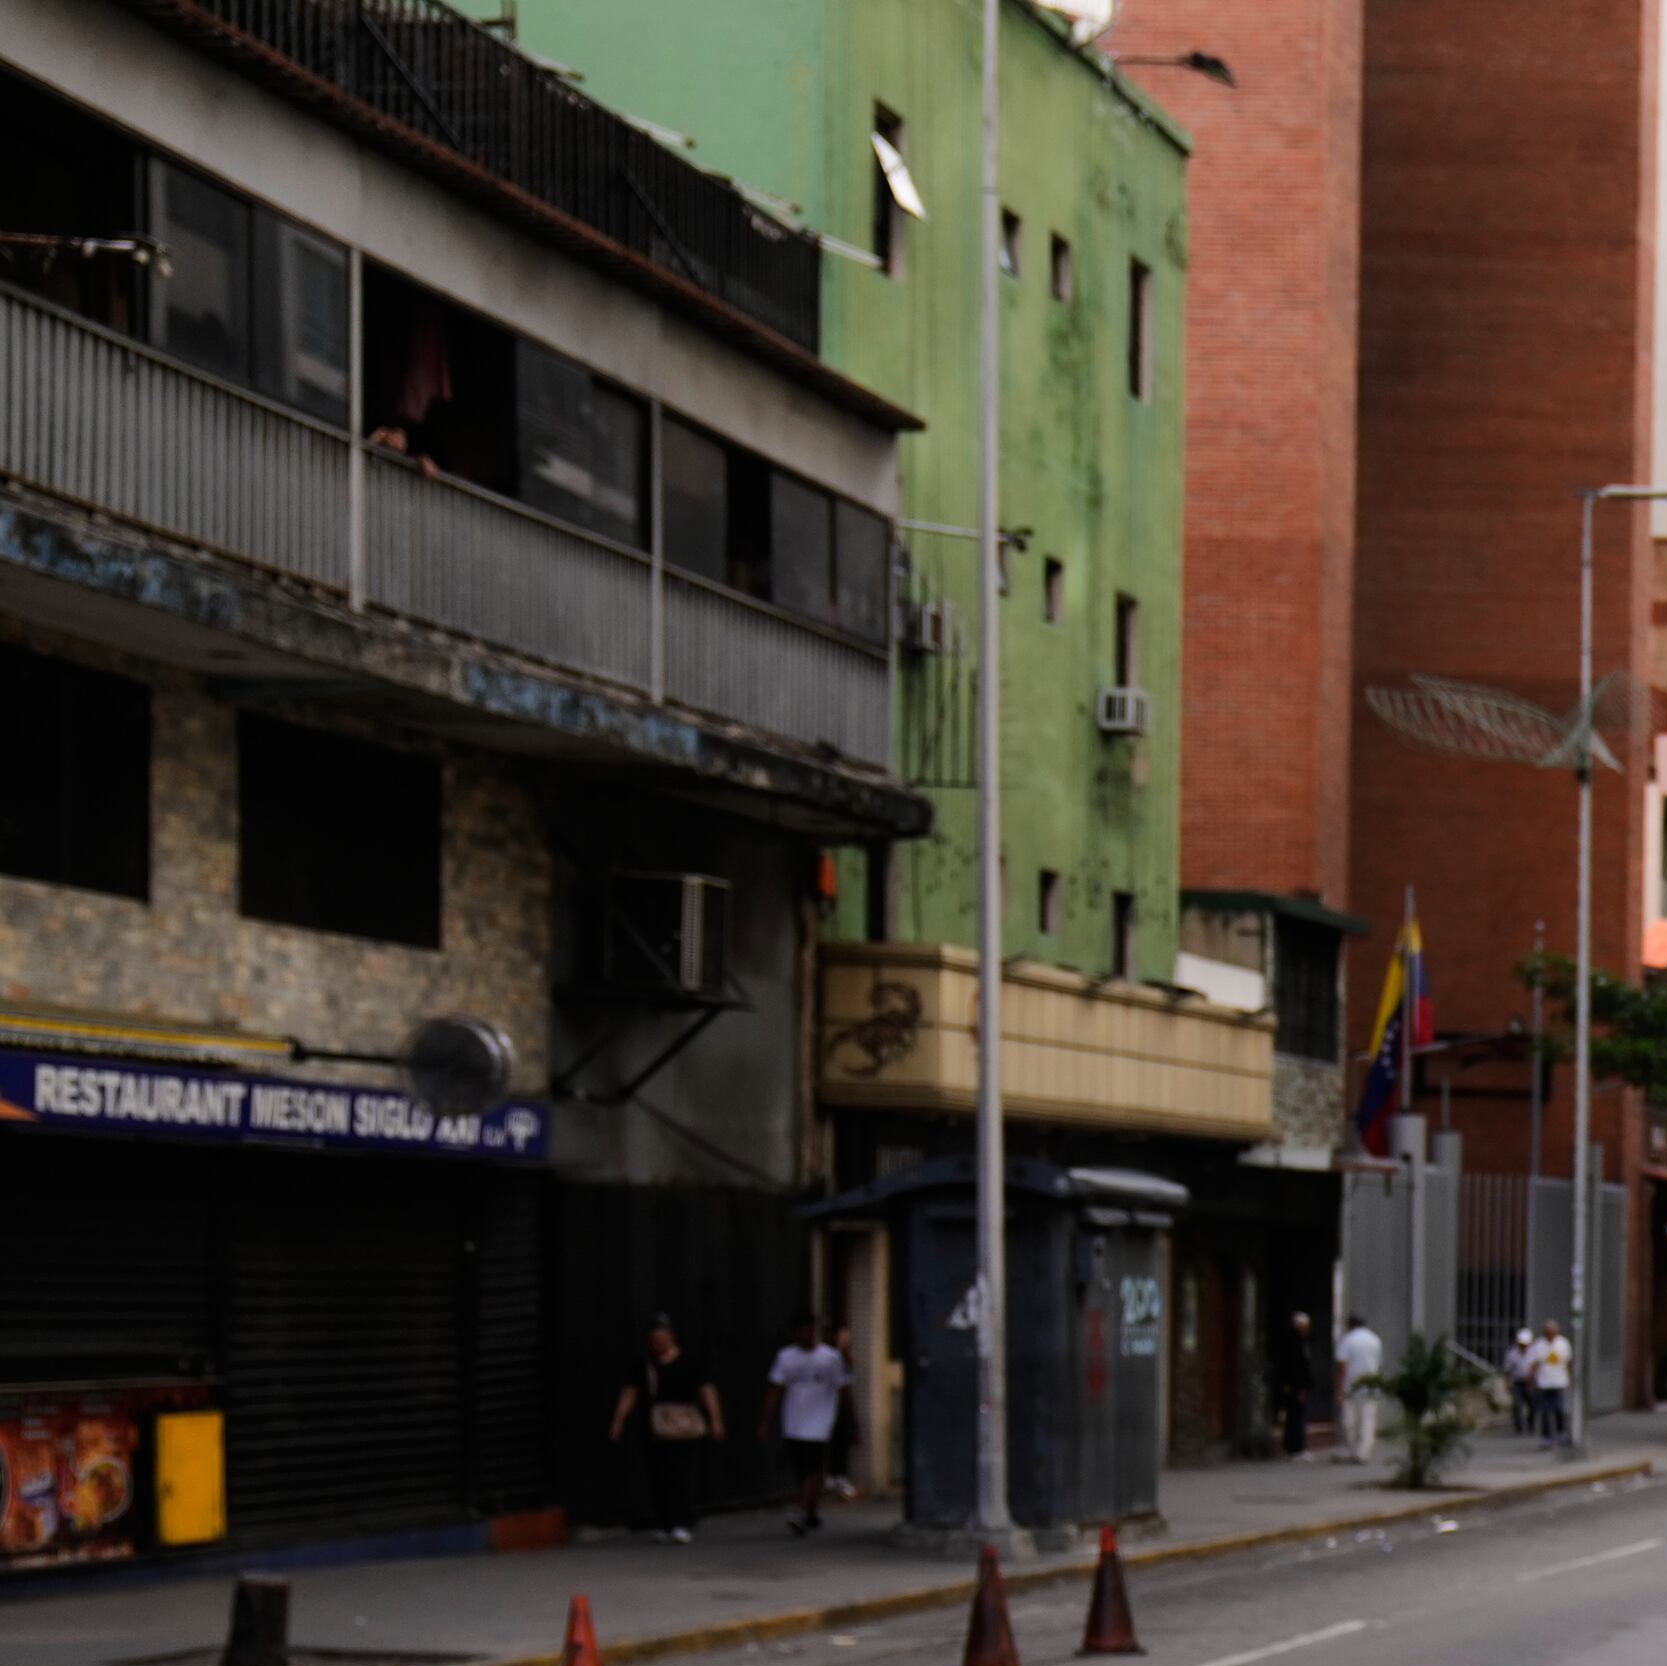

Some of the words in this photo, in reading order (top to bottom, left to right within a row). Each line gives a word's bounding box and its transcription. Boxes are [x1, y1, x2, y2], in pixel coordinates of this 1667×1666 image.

[34, 1063, 246, 1128] RESTAURANT
[250, 1085, 349, 1134] MESON
[352, 1093, 434, 1141] SIGLO
